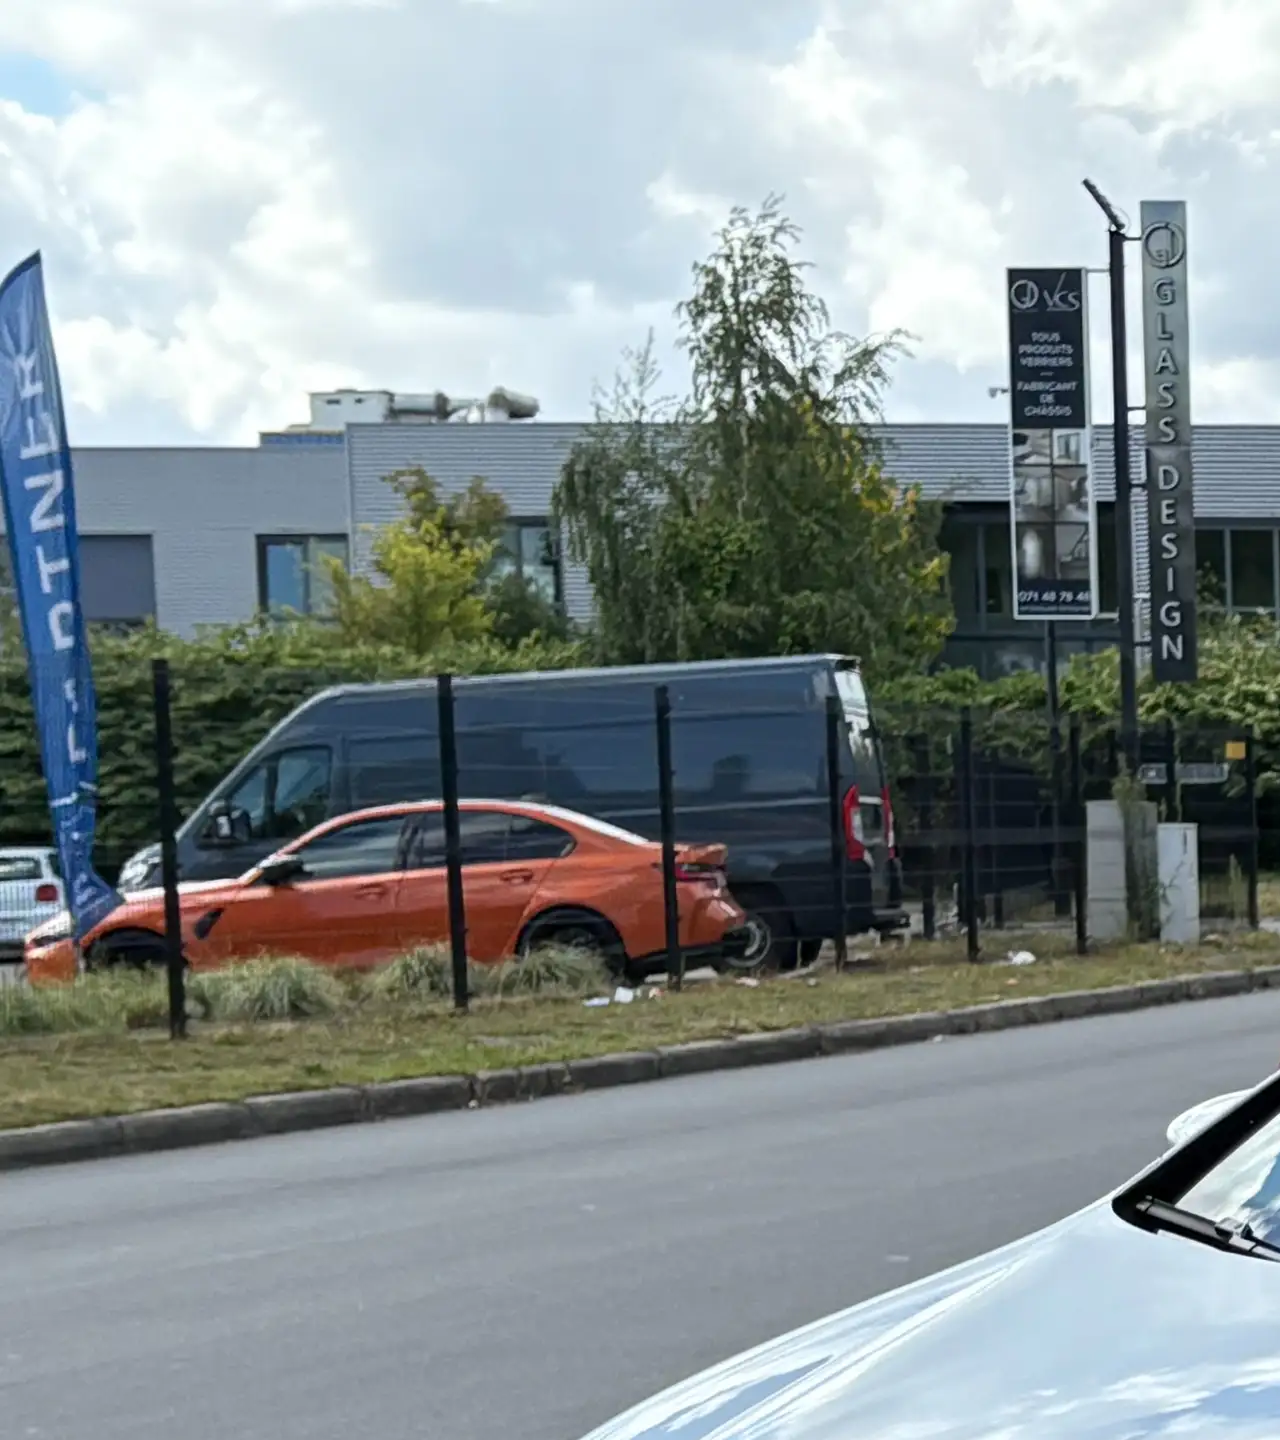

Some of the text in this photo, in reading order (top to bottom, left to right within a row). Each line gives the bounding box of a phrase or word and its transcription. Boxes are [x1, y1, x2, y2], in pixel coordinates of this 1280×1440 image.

[1042, 271, 1081, 312] VCS
[1016, 381, 1078, 391] FABRICANT
[1153, 277, 1180, 444] GLASS
[1157, 464, 1184, 661] DESIGN
